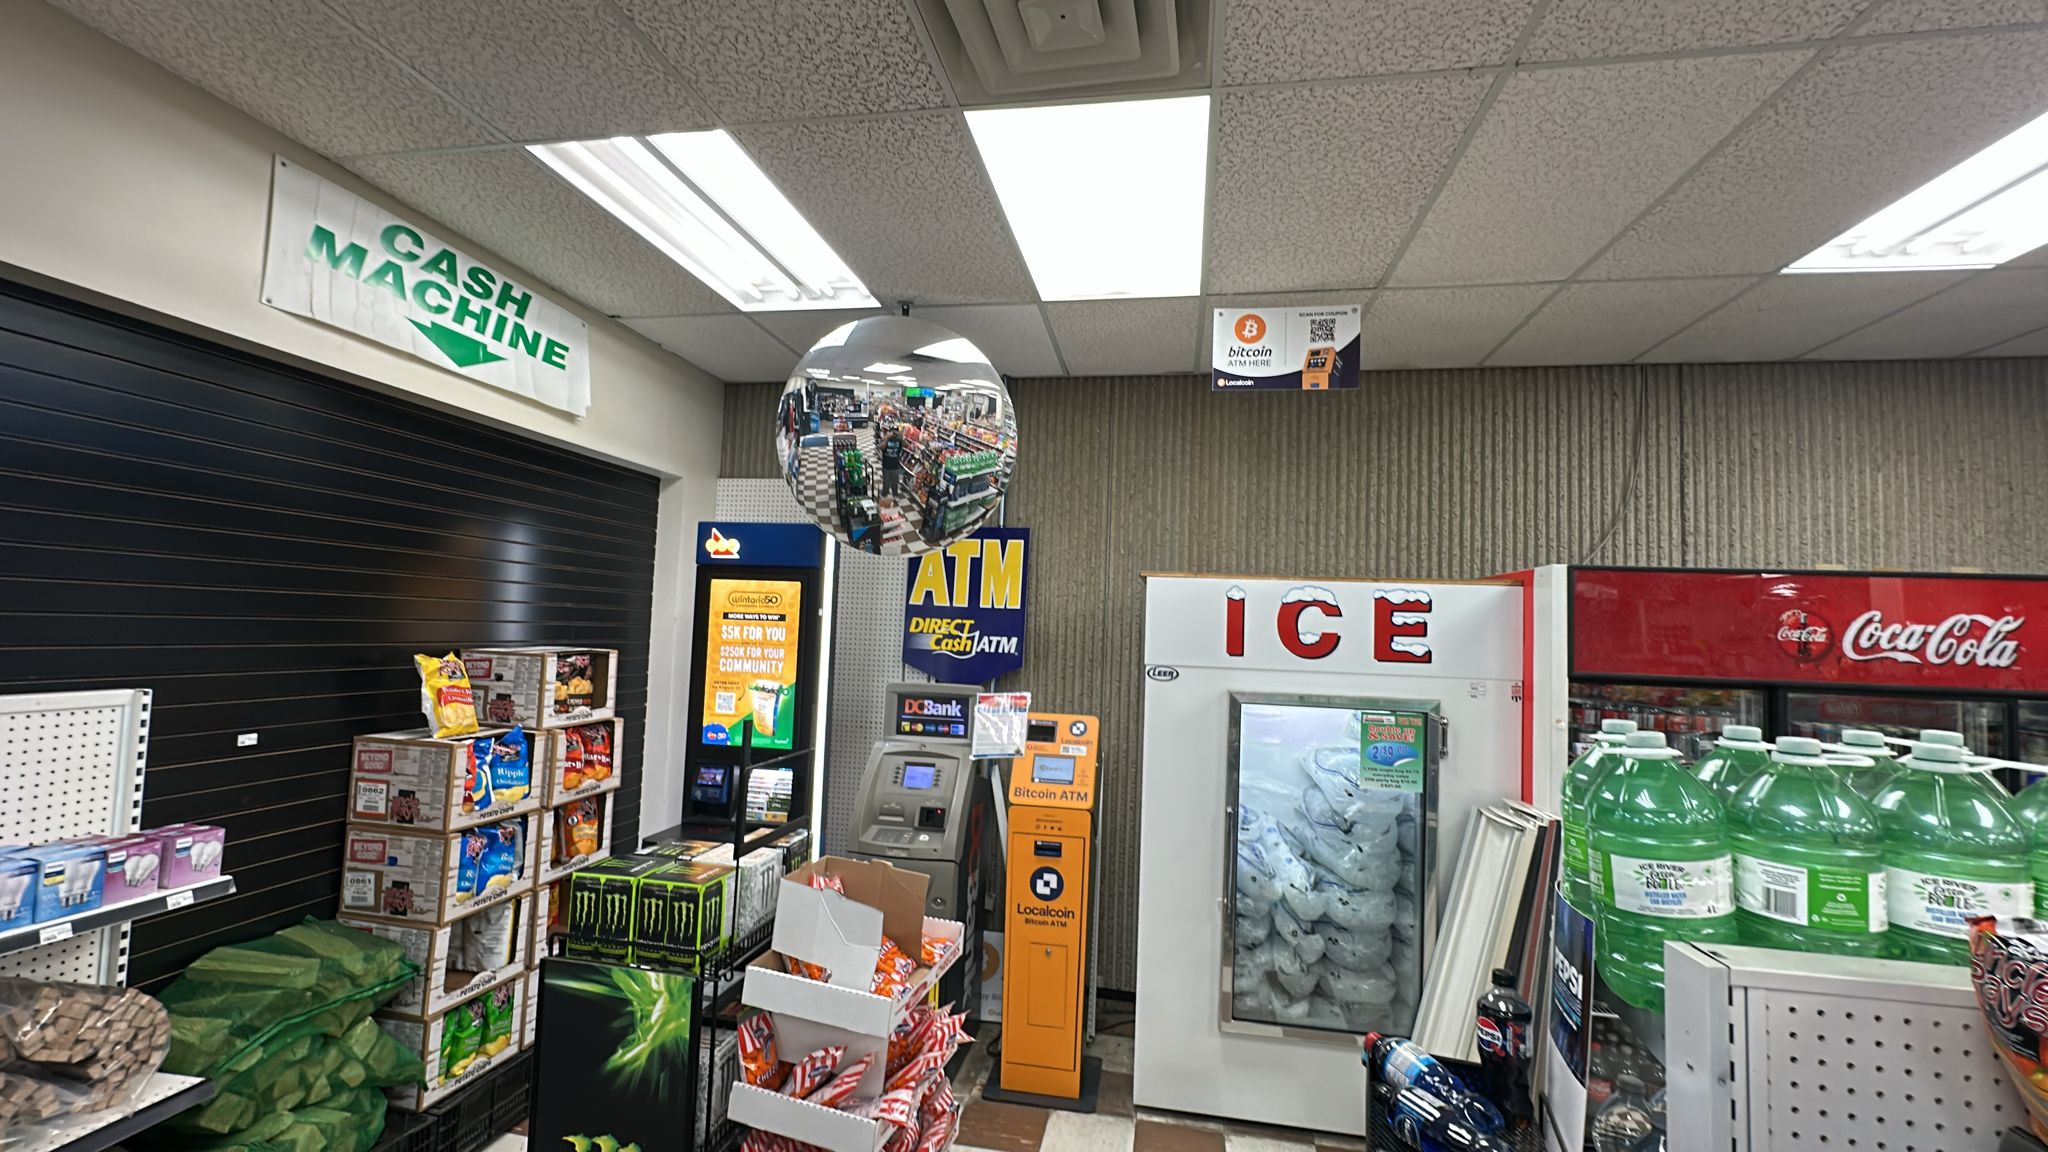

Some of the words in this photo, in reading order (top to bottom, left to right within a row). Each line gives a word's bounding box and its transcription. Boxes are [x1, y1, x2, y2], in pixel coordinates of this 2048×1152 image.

[380, 224, 532, 320] CASH
[304, 224, 570, 371] MACHINE
[1228, 345, 1272, 358] bitcoin
[1248, 359, 1271, 367] HERE
[909, 539, 1024, 609] ATM
[909, 617, 975, 635] DIRECT
[1225, 585, 1432, 663] ICE
[721, 625, 741, 639] $5K
[743, 626, 763, 640] FOR
[765, 627, 786, 641] YOU
[1777, 626, 1828, 643] Coca-Cola
[1842, 610, 2025, 668] Coca-Cola
[720, 646, 745, 657] $250K
[747, 647, 763, 658] FOR
[764, 648, 785, 659] YOUR
[977, 636, 1018, 654] ATM
[720, 658, 784, 673] COMMUNITY
[904, 699, 962, 717] DCBank
[497, 768, 524, 777] Ripple
[1014, 787, 1056, 799] Bitcoin
[1060, 790, 1088, 802] ATM
[1656, 863, 1685, 873] RIVER
[1942, 878, 1978, 892] RIVER
[1017, 903, 1075, 919] Localcoin
[1025, 918, 1049, 926] Bitcoin
[1555, 945, 1583, 1000] PEPSI
[460, 983, 480, 996] POTATO
